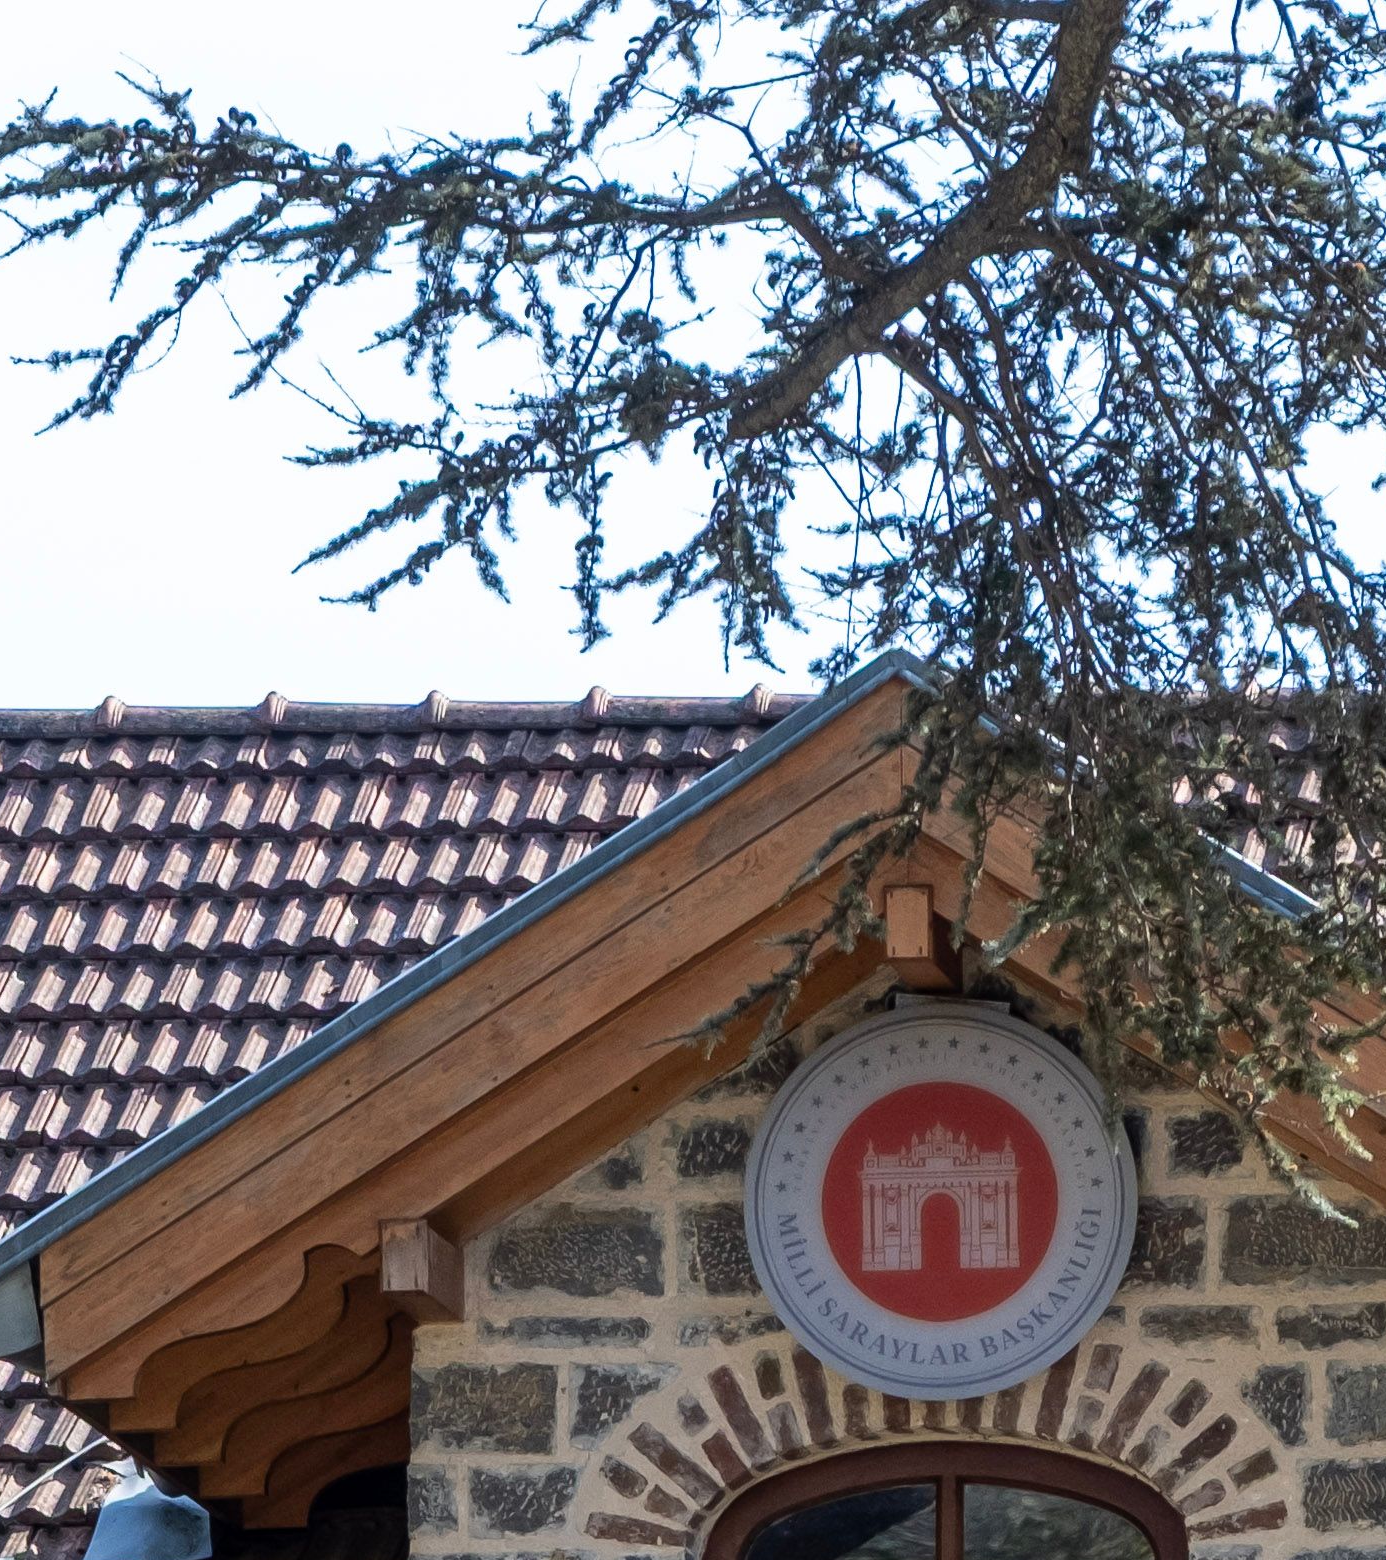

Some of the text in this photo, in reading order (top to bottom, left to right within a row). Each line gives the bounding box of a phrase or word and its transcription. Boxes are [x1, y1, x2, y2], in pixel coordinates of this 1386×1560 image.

[776, 1206, 1103, 1367] MİLLİ SARAYLAR BAŞKANLIĞI
